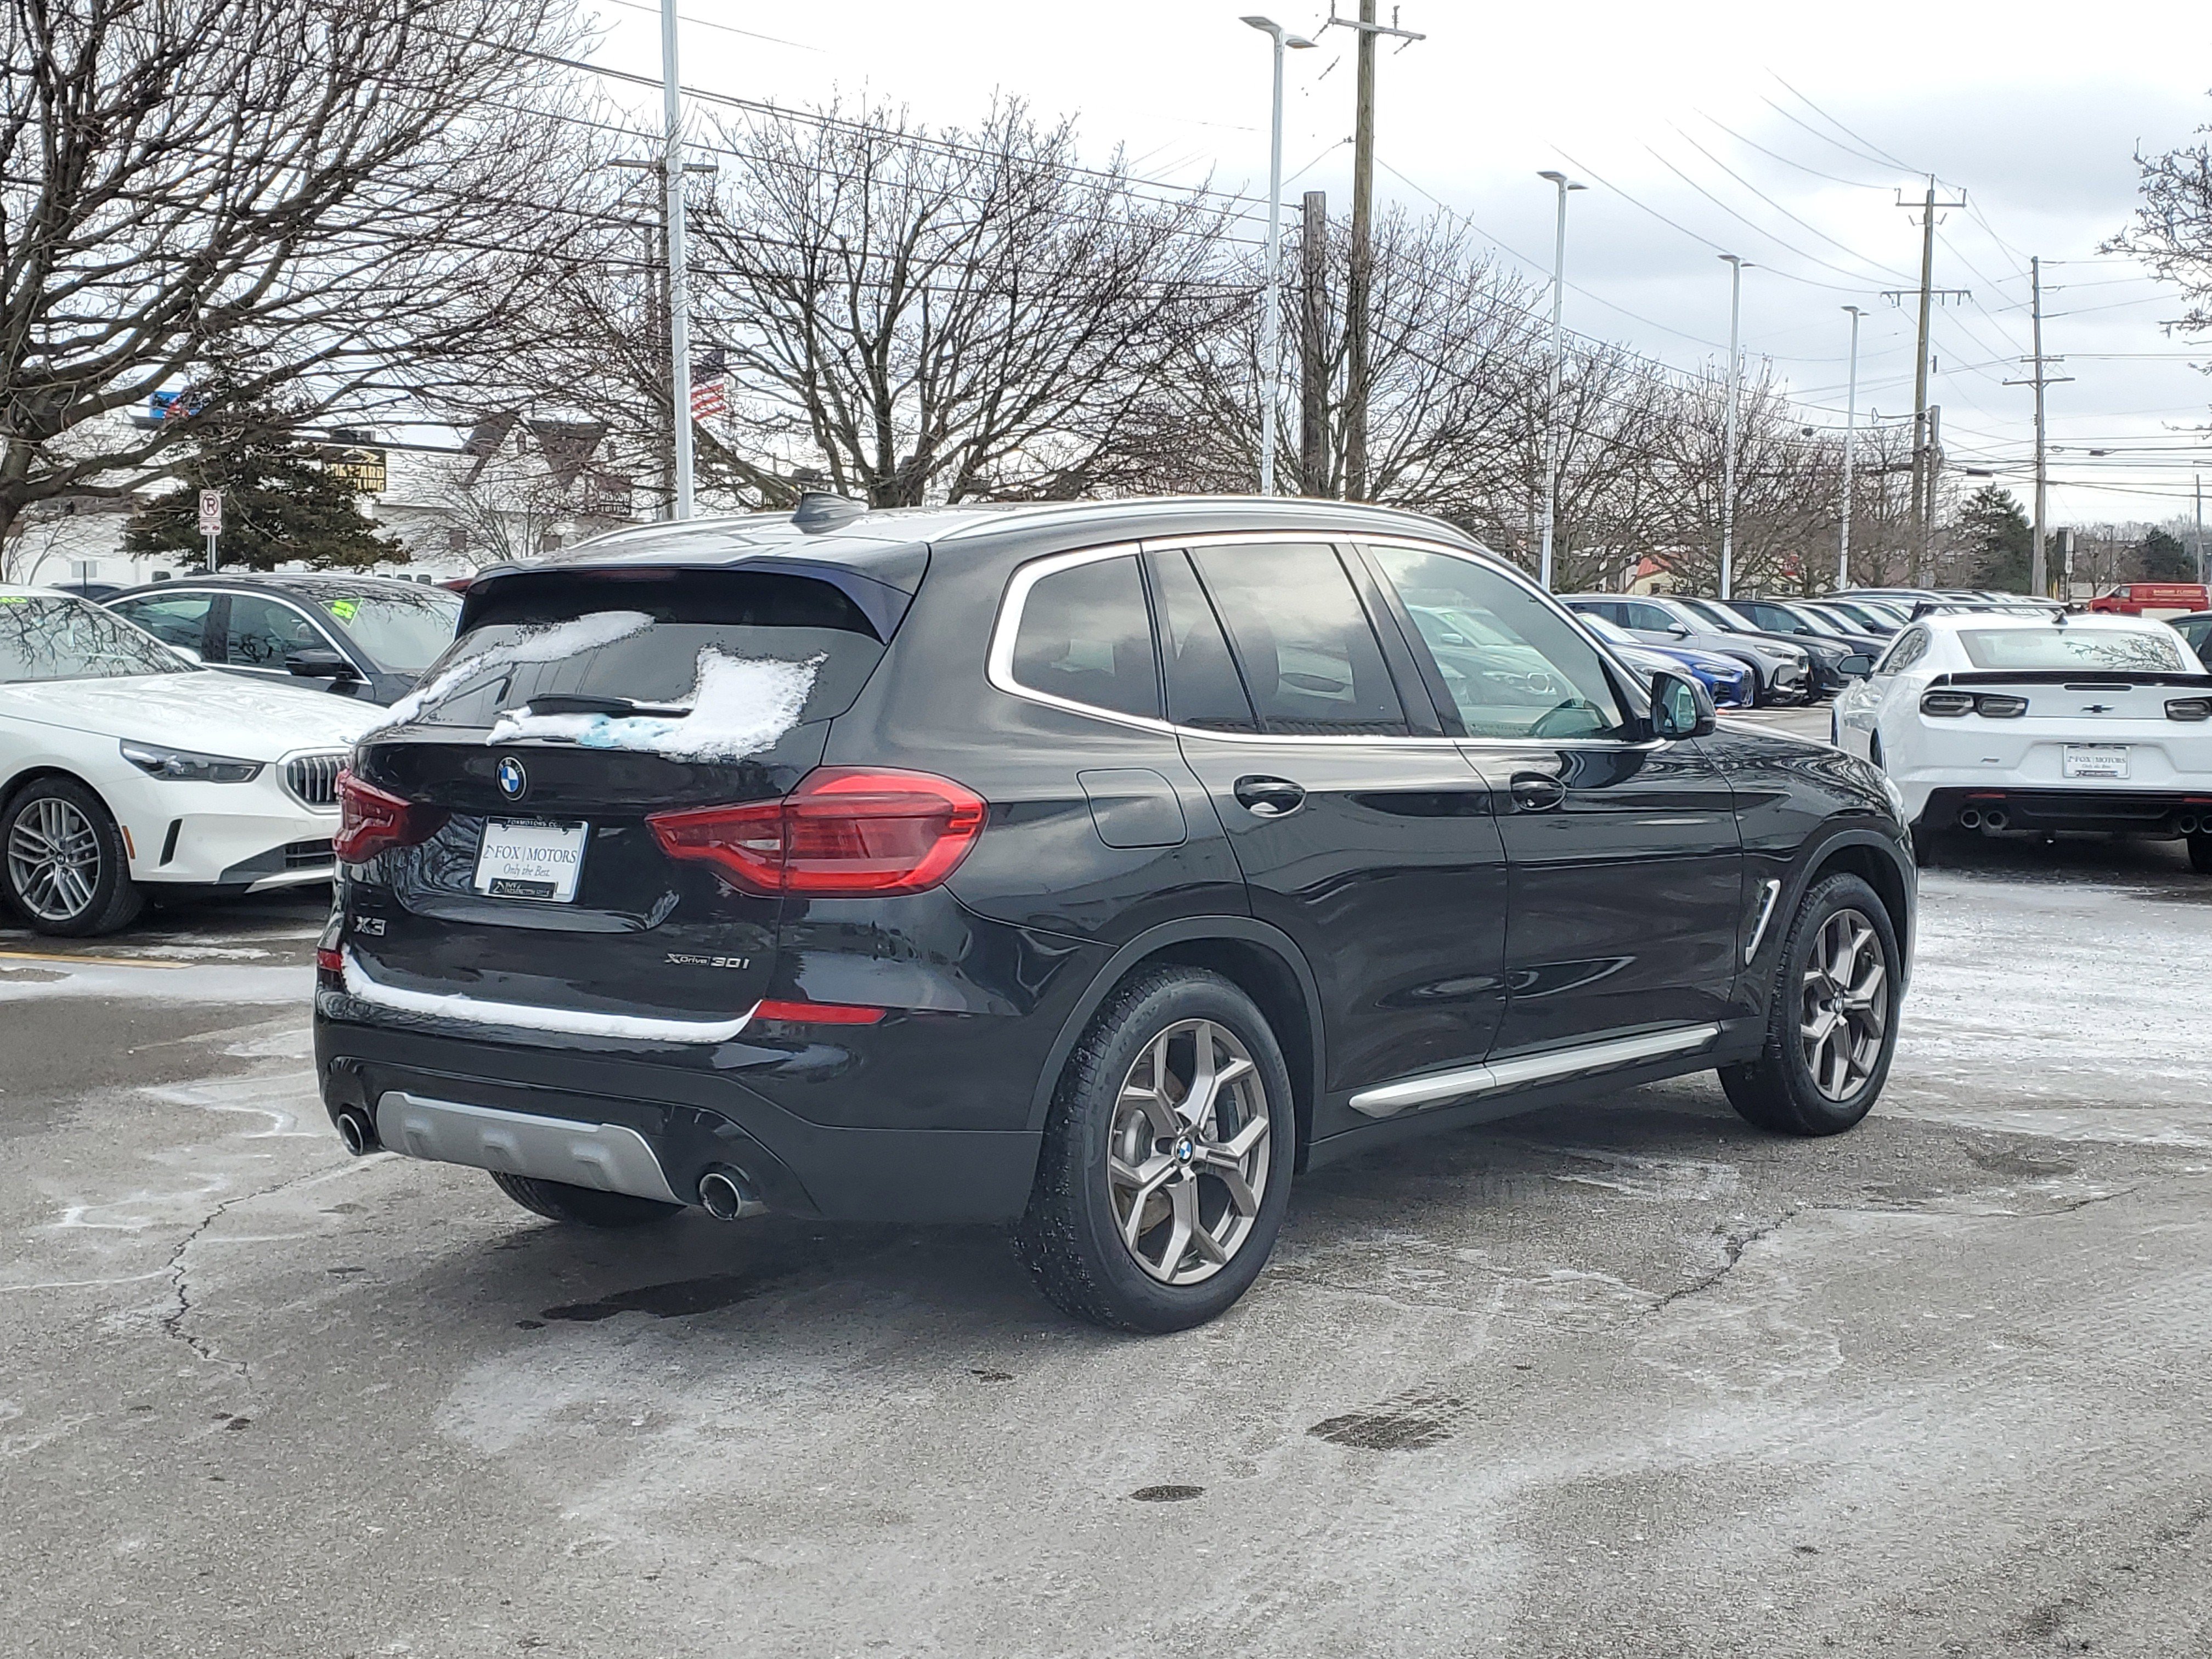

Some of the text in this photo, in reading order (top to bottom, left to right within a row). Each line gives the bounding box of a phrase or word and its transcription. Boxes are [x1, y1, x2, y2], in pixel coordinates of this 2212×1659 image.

[494, 845, 578, 864] FOX MOTORS
[504, 863, 520, 878] Only
[522, 864, 533, 876] the
[353, 916, 386, 936] X3
